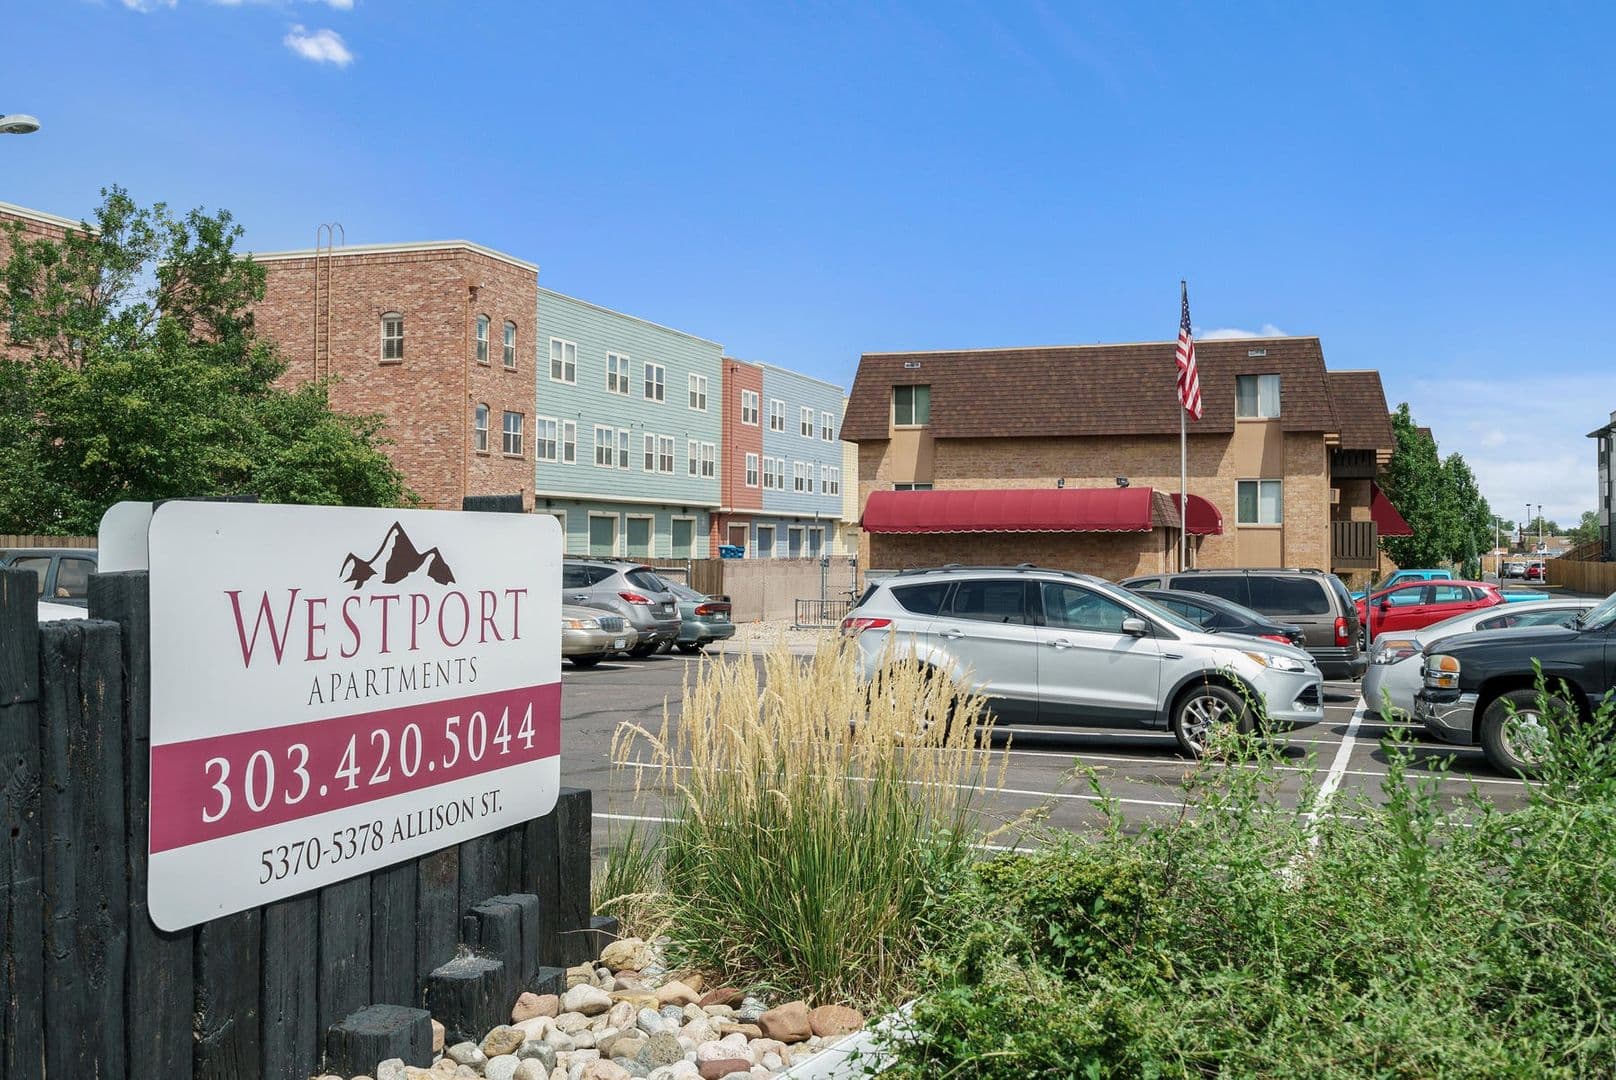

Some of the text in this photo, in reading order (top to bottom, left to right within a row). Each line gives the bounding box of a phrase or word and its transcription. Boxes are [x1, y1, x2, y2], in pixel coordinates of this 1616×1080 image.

[224, 588, 528, 669] WESTPORT
[307, 656, 478, 706] APARTMENTS
[201, 701, 536, 824] 303.420.5044
[259, 788, 503, 885] 5370-5378 ALLISON ST.
